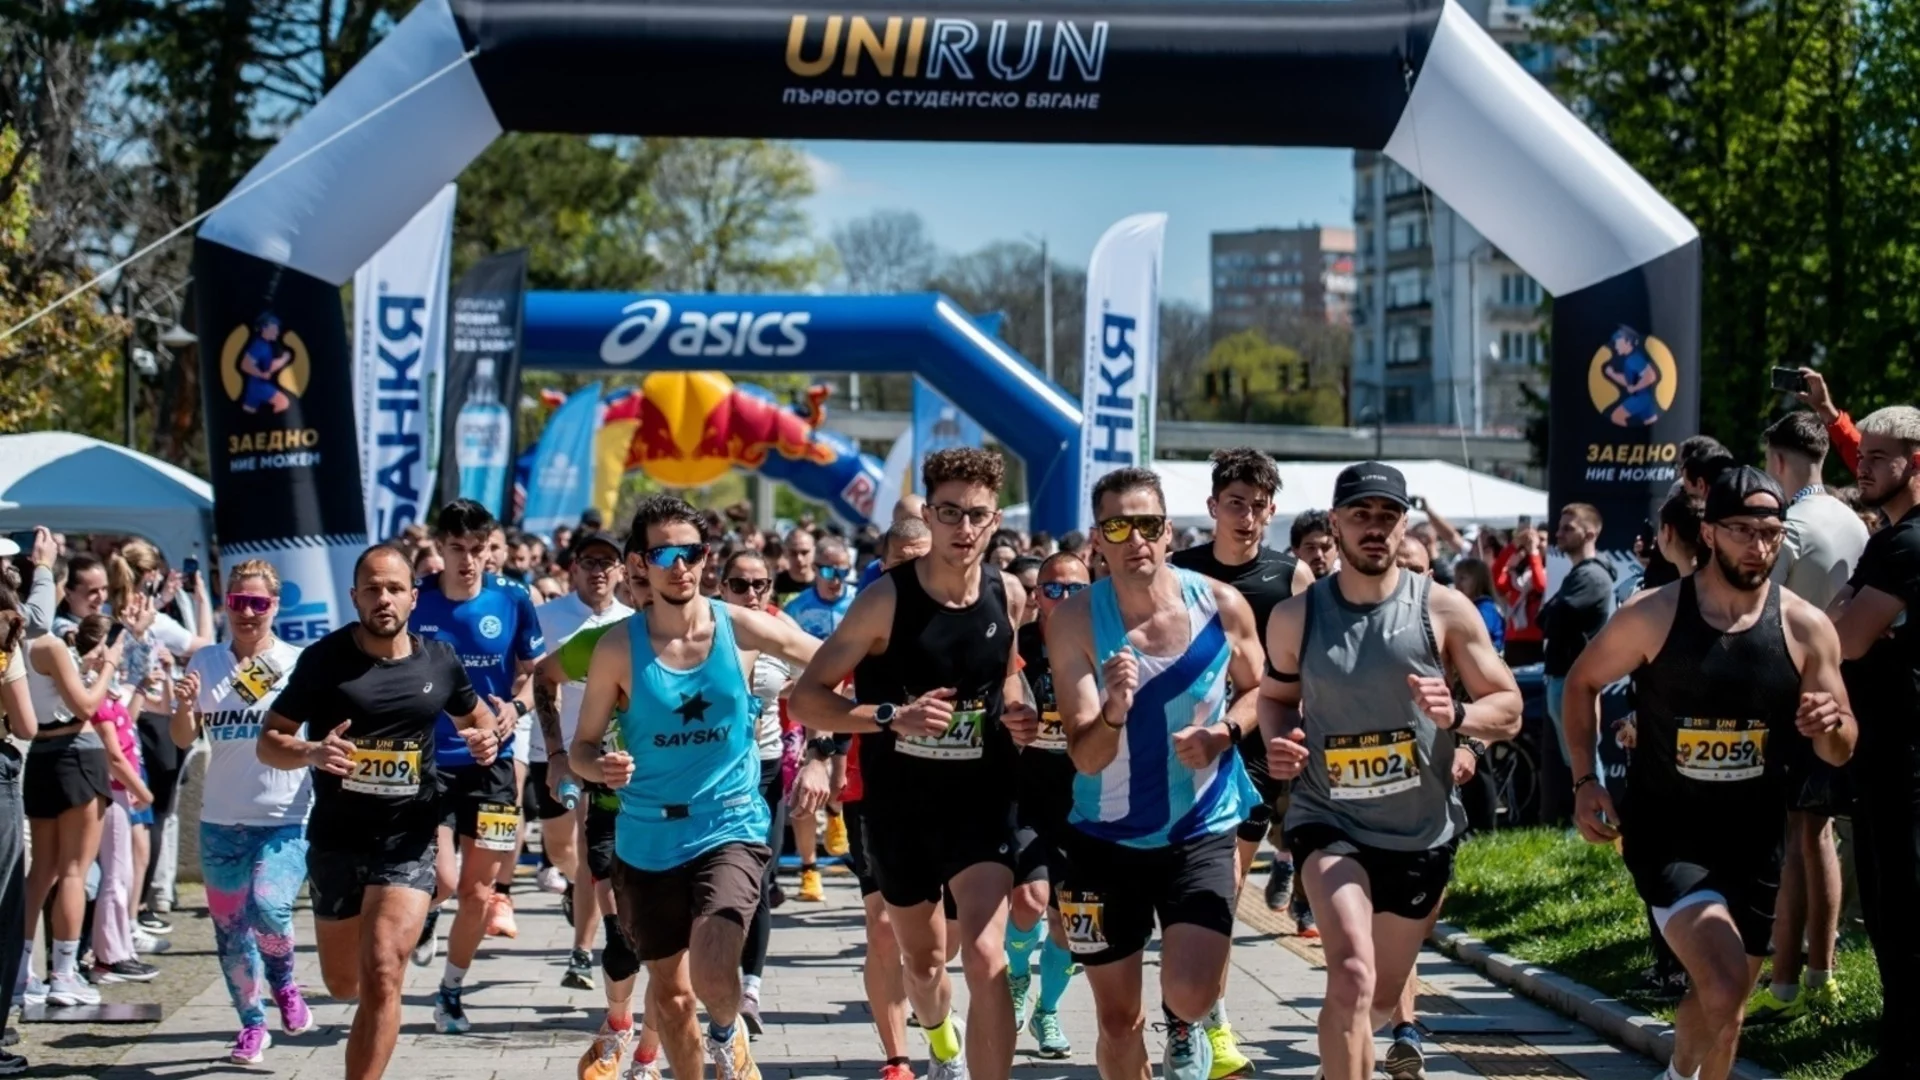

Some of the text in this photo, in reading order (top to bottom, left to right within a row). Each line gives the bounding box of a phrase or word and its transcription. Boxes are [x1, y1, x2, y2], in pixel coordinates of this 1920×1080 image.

[785, 15, 1109, 82] UNIRUN
[783, 88, 1101, 109] ПЪРВОТО СТУДЕНТСКО БЯГАНЕ
[1092, 313, 1137, 465] НКЯ
[228, 428, 319, 454] ЗАЕДНО
[230, 451, 320, 472] НИЕ МОЖЕМ
[1586, 443, 1677, 465] ЗАЕДНО
[1585, 467, 1677, 481] НИЕ МОЖЕМ
[271, 619, 331, 641] ББ
[653, 725, 732, 748] SAYSKY
[943, 721, 976, 740] 47
[1695, 740, 1755, 761] 2059
[359, 758, 410, 777] 2109
[1349, 754, 1403, 779] 1102
